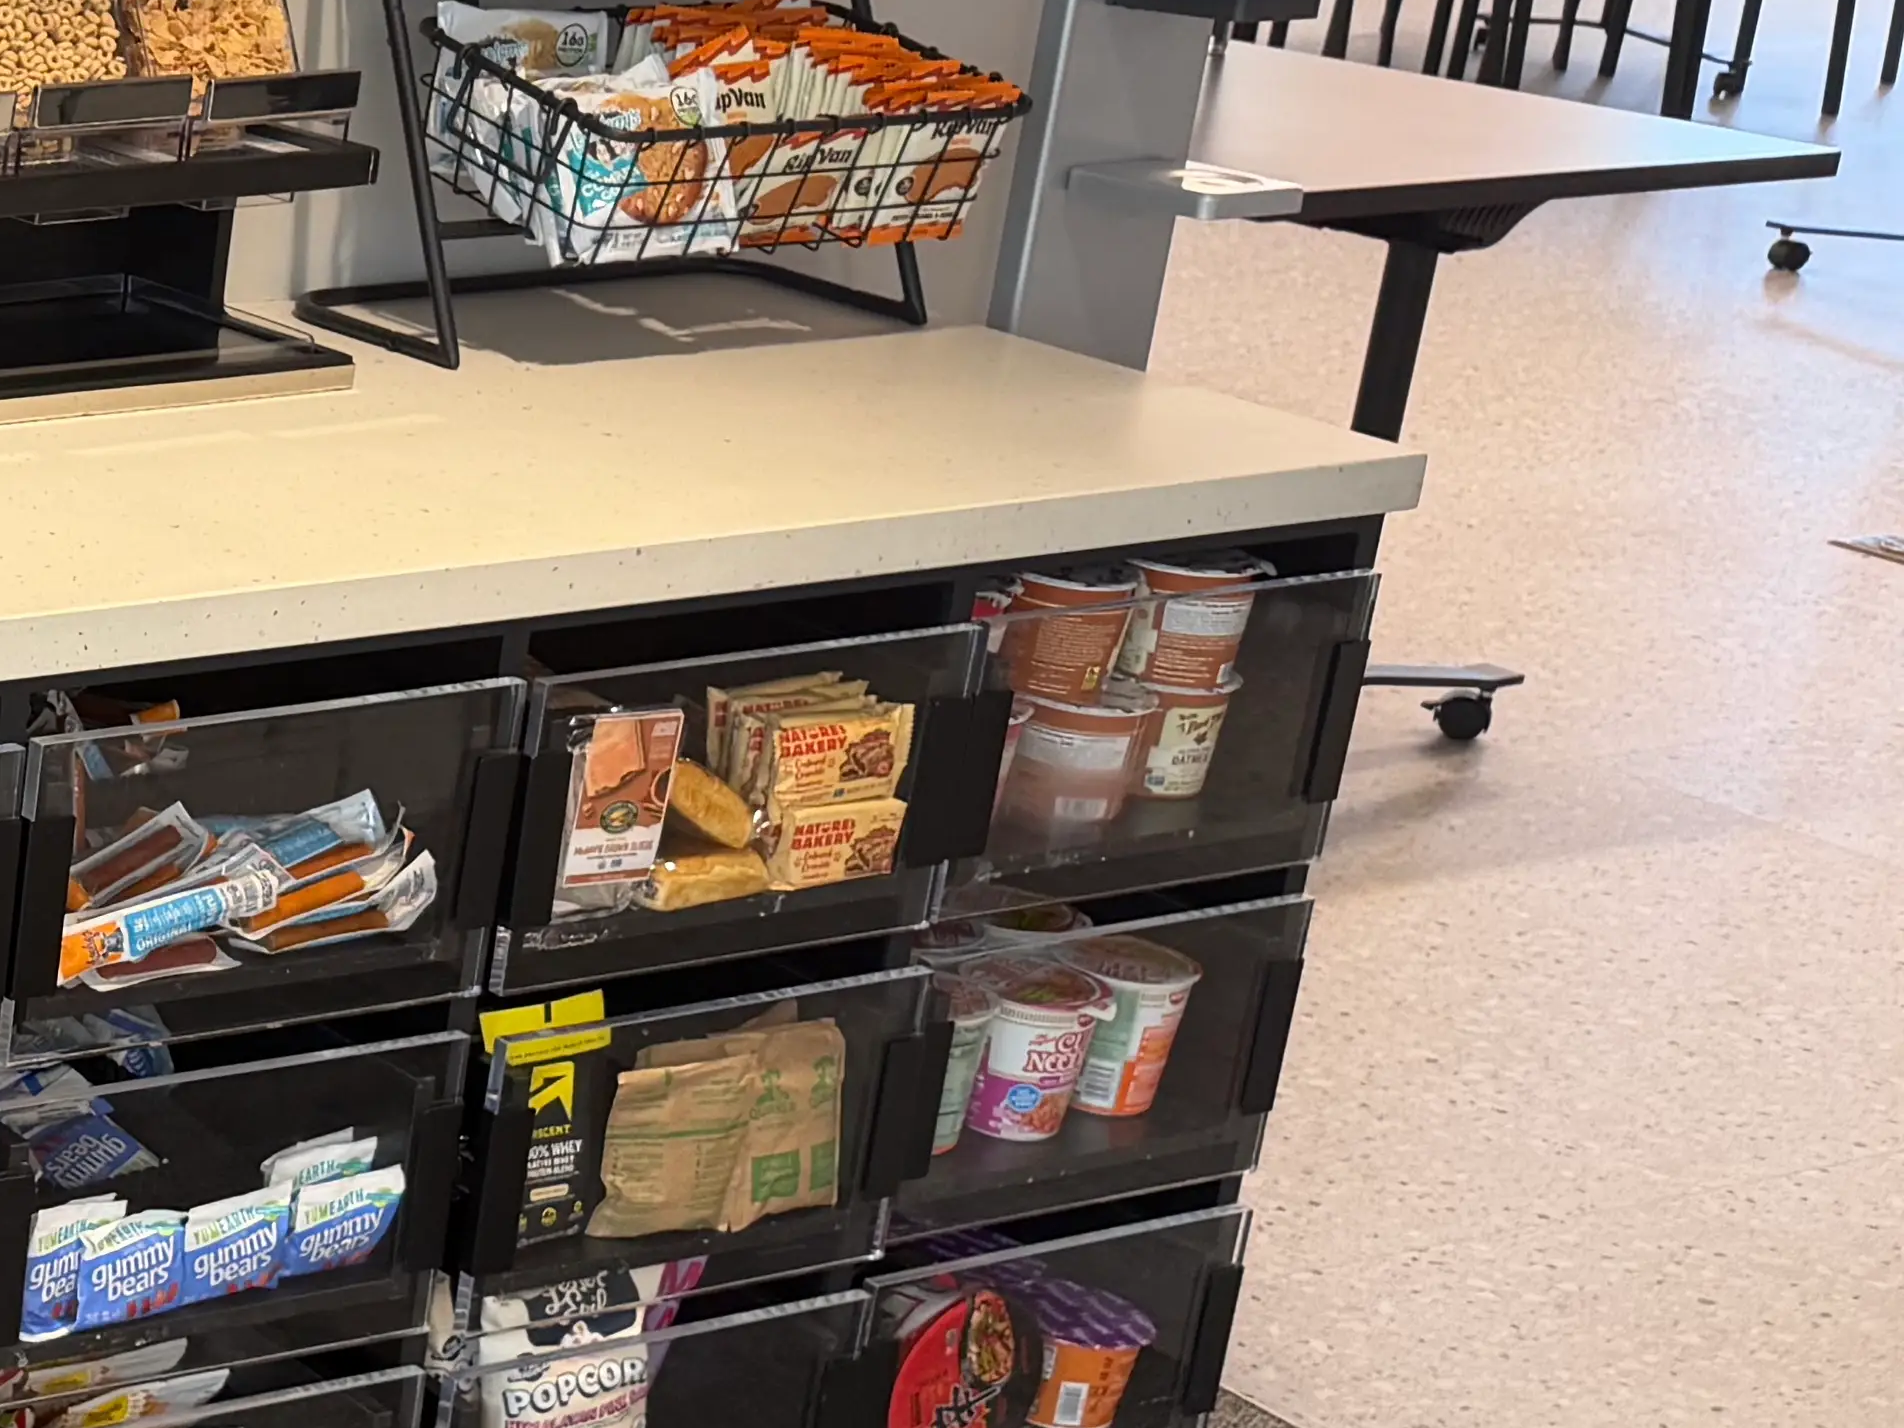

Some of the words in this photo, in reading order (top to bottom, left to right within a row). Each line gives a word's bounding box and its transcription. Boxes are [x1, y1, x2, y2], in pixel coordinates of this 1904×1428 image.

[780, 736, 847, 758] BAKERY
[791, 831, 854, 850] BAKERY
[194, 1221, 277, 1279] gummy
[299, 1208, 385, 1257] gummy
[310, 1233, 370, 1264] bears
[91, 1236, 174, 1292] gummy
[210, 1251, 272, 1286] bears
[107, 1264, 169, 1302] bears
